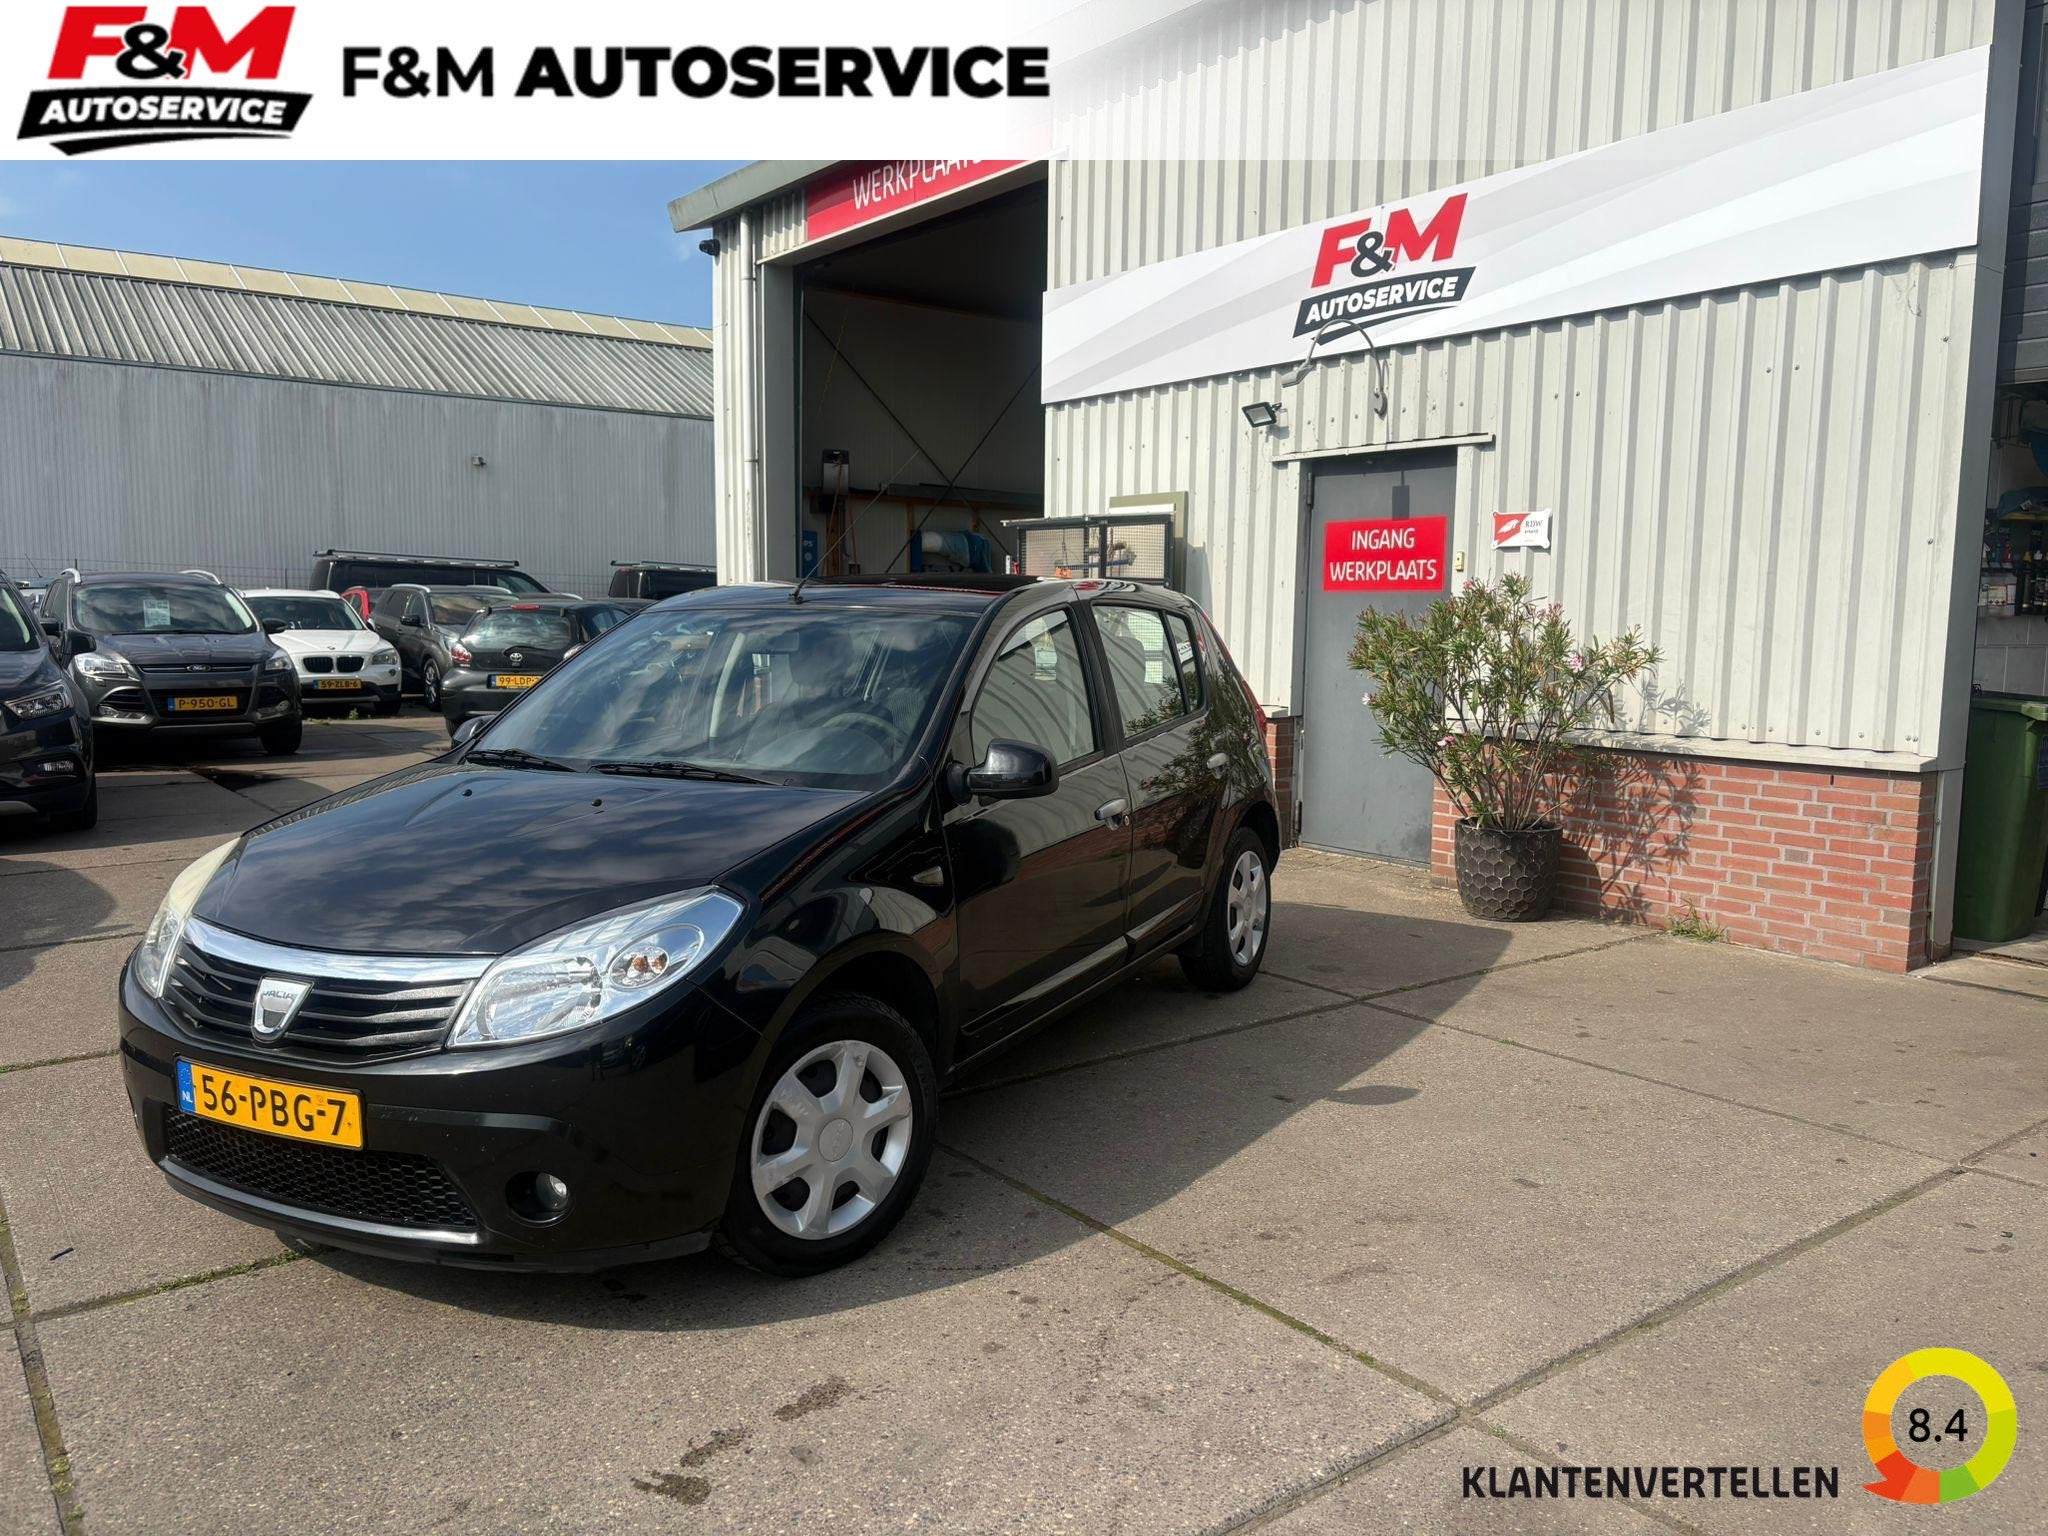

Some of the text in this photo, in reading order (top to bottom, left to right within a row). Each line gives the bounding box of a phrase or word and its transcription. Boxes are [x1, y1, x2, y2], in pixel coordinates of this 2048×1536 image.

[1311, 192, 1468, 289] F&M
[1305, 276, 1459, 325] AUTOSERVICE
[1351, 527, 1415, 551] INGANG
[1329, 559, 1437, 582] WERKPLAATS
[178, 697, 235, 709] P-950-GL
[201, 1073, 347, 1137] 56-PBG-7
